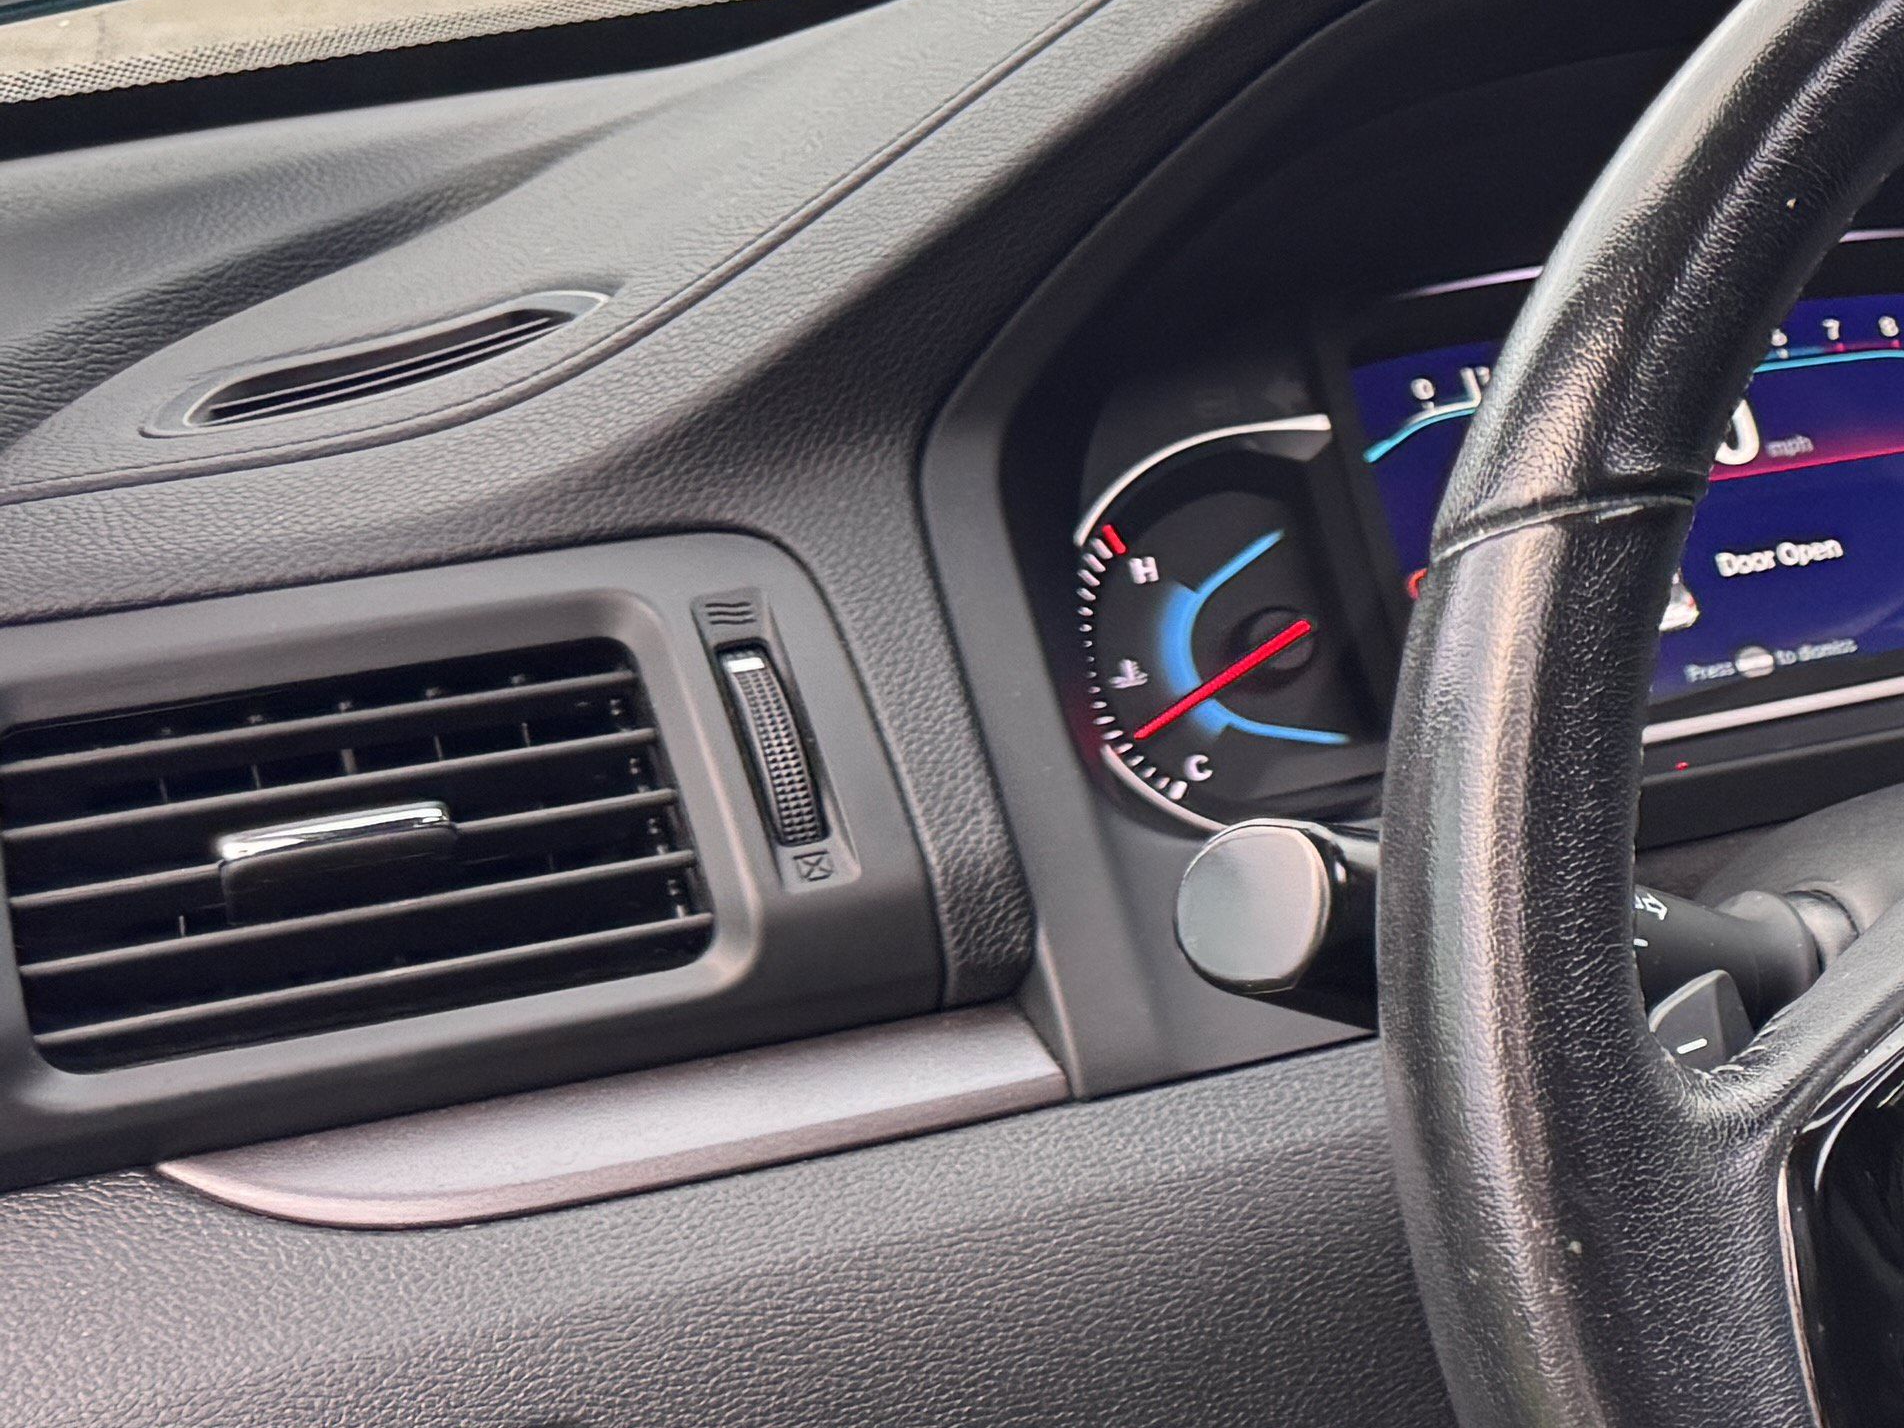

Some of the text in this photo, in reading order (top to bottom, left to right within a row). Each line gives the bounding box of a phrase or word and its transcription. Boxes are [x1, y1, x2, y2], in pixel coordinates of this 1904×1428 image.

[1822, 319, 1840, 340] 7
[1129, 556, 1159, 584] H
[1715, 539, 1844, 577] Door Open
[1685, 662, 1735, 684] Press
[1184, 754, 1212, 782] C
